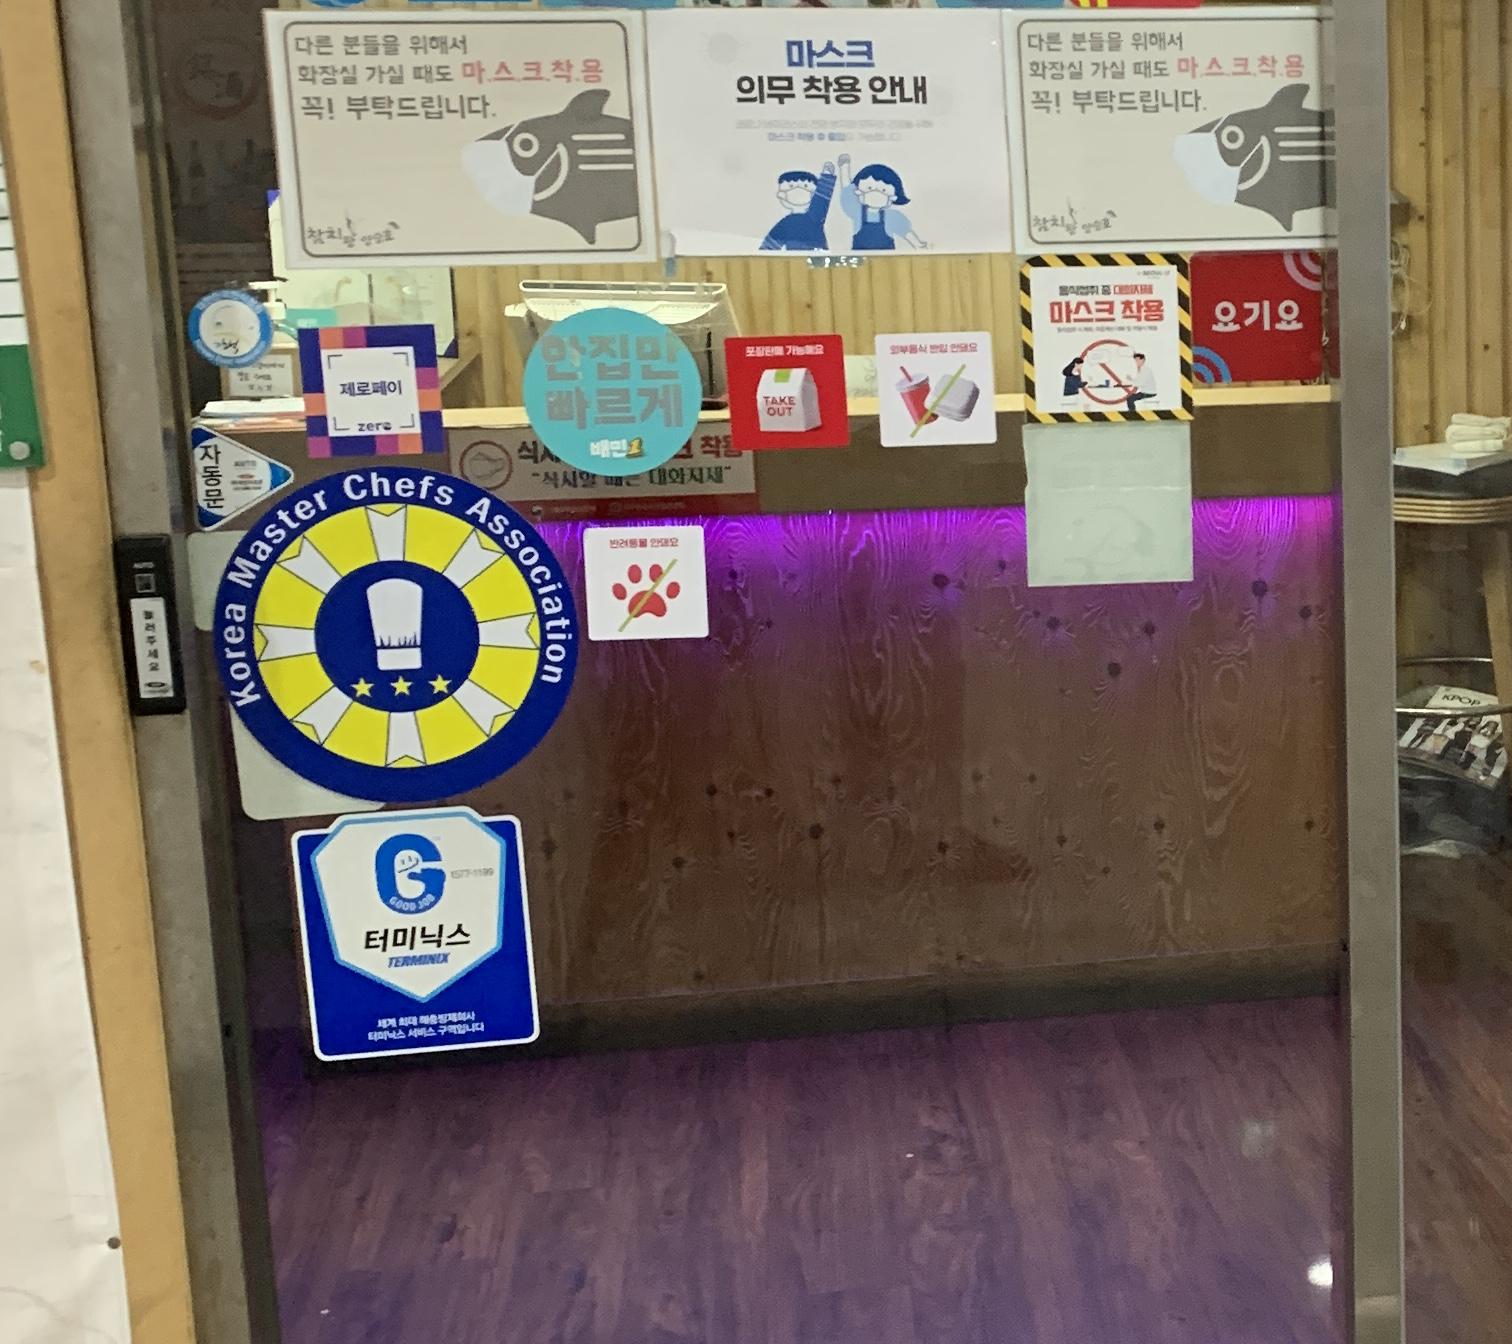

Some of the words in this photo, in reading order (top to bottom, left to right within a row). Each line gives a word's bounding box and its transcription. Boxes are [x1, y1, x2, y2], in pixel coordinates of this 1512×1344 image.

[295, 36, 334, 56] 다른
[342, 35, 400, 56] 분들을
[409, 35, 468, 55] 위해서
[786, 39, 875, 68] 마스크
[1027, 32, 1063, 51] 다른
[1071, 32, 1123, 51] 분들을
[1131, 32, 1183, 51] 위해서
[298, 65, 358, 84] 화장실
[367, 65, 404, 84] 가실
[413, 64, 453, 83] 때도
[1029, 60, 1083, 81] 화장실
[1090, 60, 1126, 81] 가실
[1132, 60, 1170, 80] 때도
[736, 75, 795, 104] 의무
[803, 75, 861, 104] 착용
[868, 75, 927, 104] 안내
[1031, 90, 1062, 115] 꼭!
[1072, 89, 1208, 114] 부탁드립니다.
[302, 96, 334, 120] 꼭!
[346, 95, 496, 120] 부탁드립니다.
[1049, 300, 1115, 323] 마스크
[1121, 299, 1165, 322] 착용
[1212, 300, 1303, 334] 요기요
[340, 379, 402, 396] 제로페이
[546, 384, 683, 429] 빠르게
[763, 396, 796, 406] TAKE
[767, 407, 792, 417] OUT
[199, 444, 225, 509] 자동문
[343, 472, 455, 506] Chefs
[229, 490, 328, 590] Master
[465, 496, 574, 684] Association
[224, 604, 261, 708] Korea
[1442, 694, 1481, 706] KPOP
[364, 923, 471, 953] 터미닉스
[387, 952, 451, 969] TERMINIX
